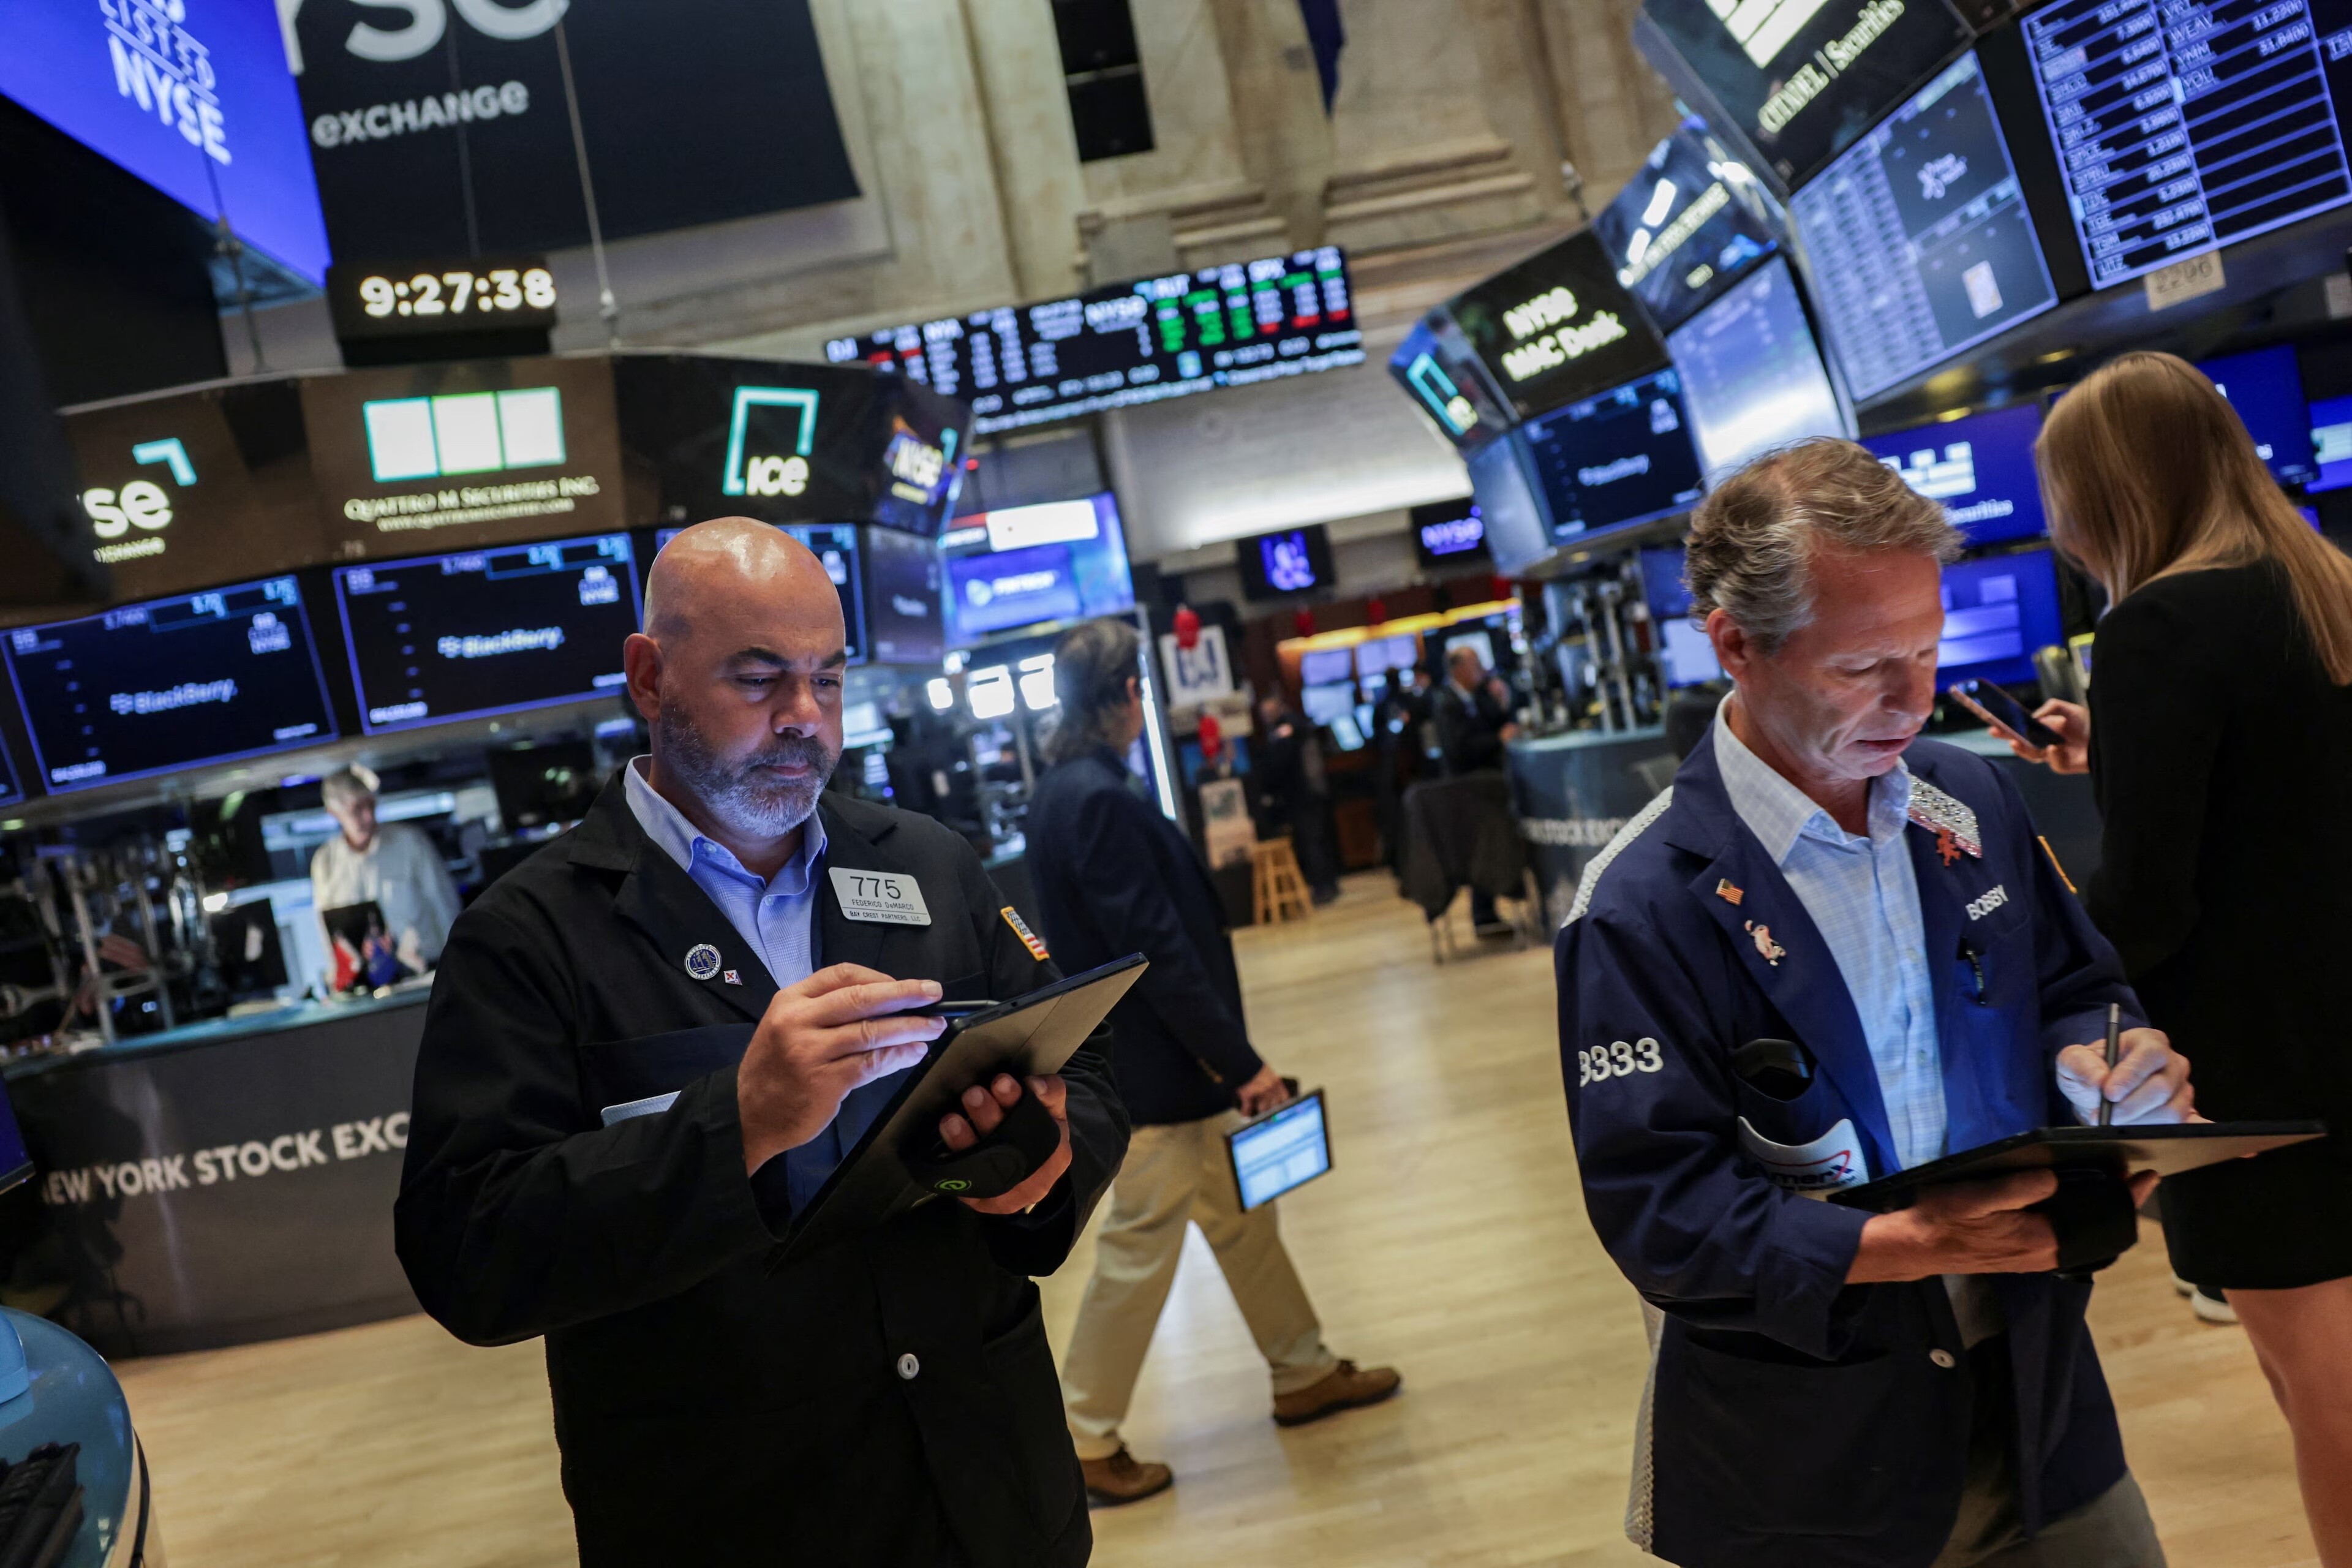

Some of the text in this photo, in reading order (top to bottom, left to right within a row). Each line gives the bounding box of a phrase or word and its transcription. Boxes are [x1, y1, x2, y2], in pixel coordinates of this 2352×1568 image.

[107, 33, 232, 167] NYSE
[360, 269, 557, 317] 9:27:38
[850, 876, 901, 900] 775
[851, 899, 914, 911] FEDERICO DeMARCO
[1965, 884, 2009, 921] BOBBY
[94, 1153, 190, 1199] YORK
[193, 1130, 328, 1185] STOCK
